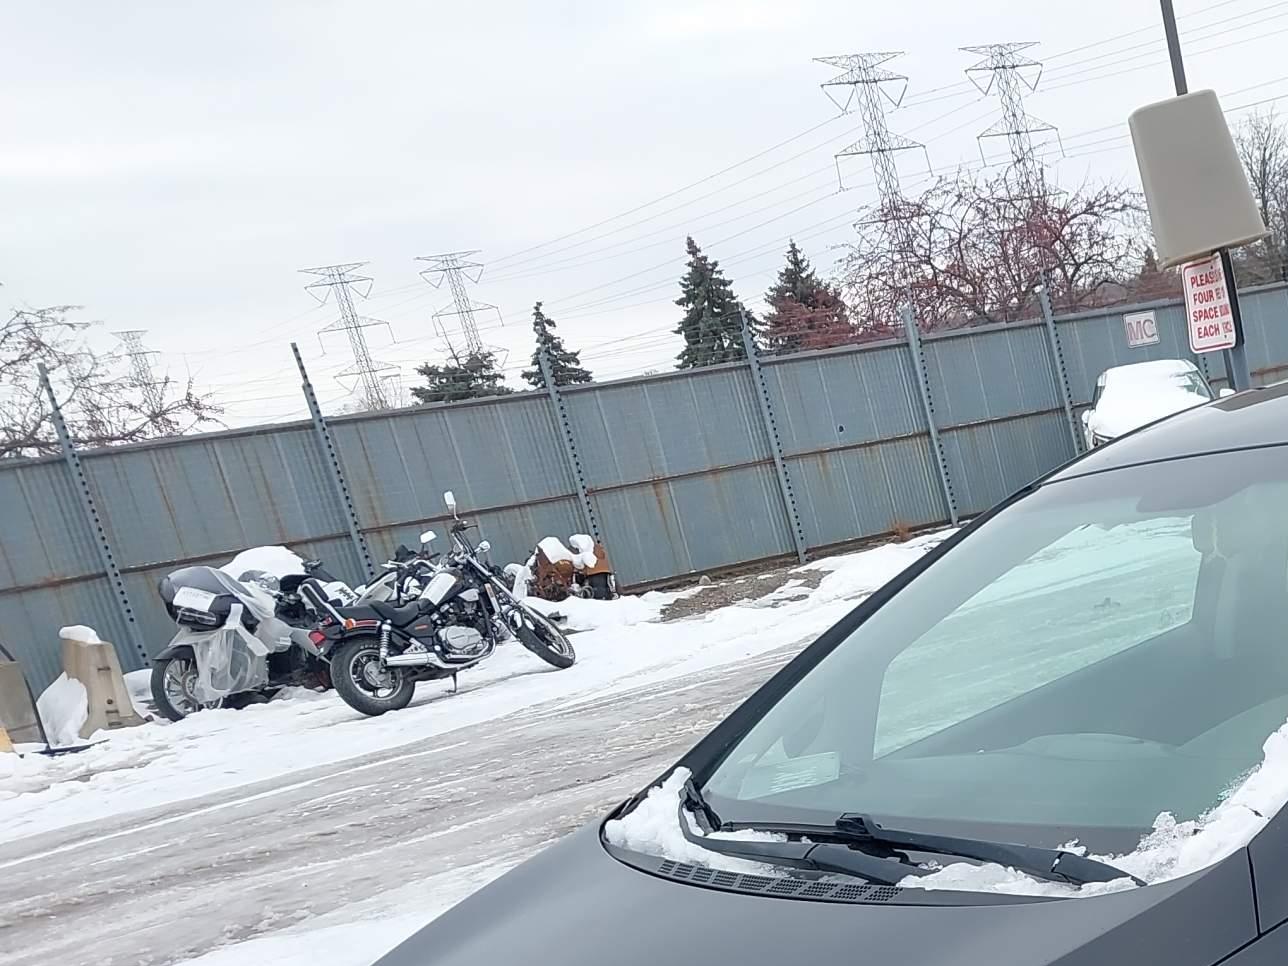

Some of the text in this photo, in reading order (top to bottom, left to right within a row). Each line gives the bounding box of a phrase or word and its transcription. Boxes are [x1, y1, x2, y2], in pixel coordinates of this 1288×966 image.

[1193, 289, 1215, 305] FOUR
[1192, 306, 1219, 322] SPACE
[1127, 319, 1156, 341] MC
[1197, 323, 1220, 339] EACH
